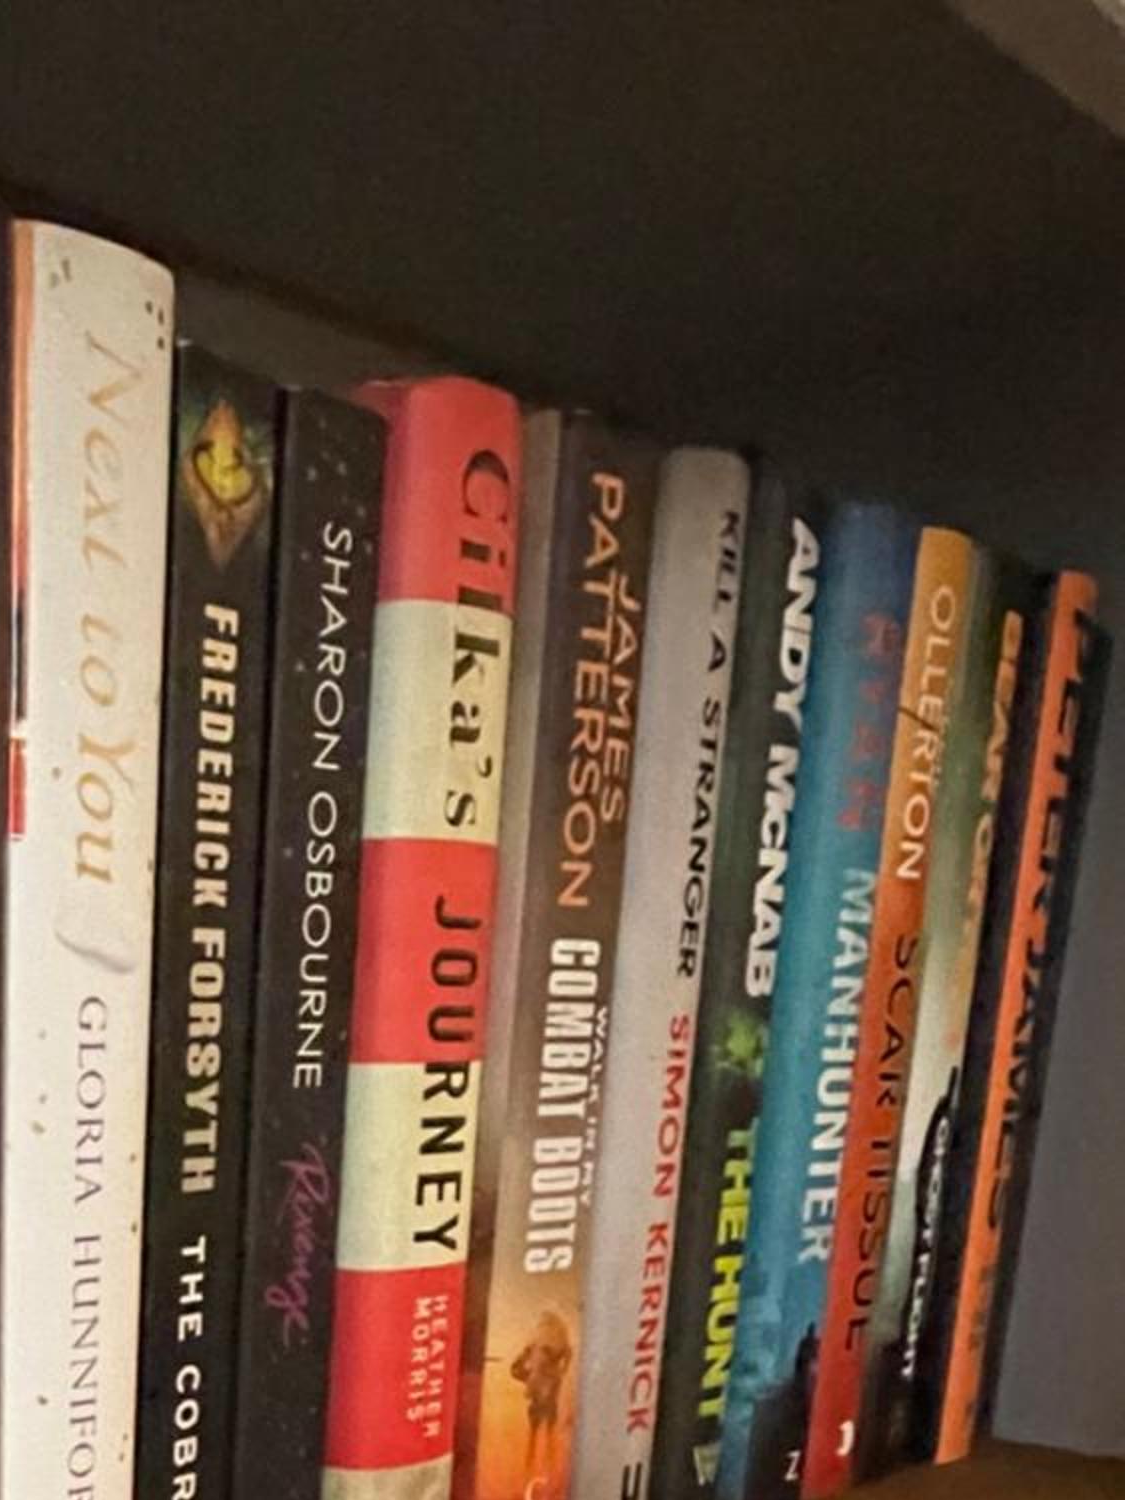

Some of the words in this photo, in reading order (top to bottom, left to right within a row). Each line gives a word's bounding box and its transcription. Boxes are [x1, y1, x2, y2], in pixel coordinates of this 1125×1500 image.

[82, 329, 145, 574] Next
[81, 614, 125, 708] to
[313, 521, 353, 772] SHARON
[706, 632, 728, 673] A
[716, 510, 741, 612] KILL
[774, 516, 821, 735] ANDY
[192, 602, 240, 906] FREDERICK
[556, 471, 626, 908] PATTERSON
[599, 568, 642, 824] JAMES
[896, 584, 957, 880] OLLERTON
[75, 732, 137, 884] You
[676, 697, 727, 979] STRANGER
[744, 743, 801, 999] McNAB
[293, 790, 338, 1089] OSBOURNE
[535, 937, 601, 1119] COMBAT
[874, 933, 923, 1108] SCAR
[75, 994, 107, 1204] GLORIA
[180, 924, 227, 1195] FORSYTH
[412, 896, 483, 1252] JOURNEY
[653, 1012, 691, 1200] SIMON
[797, 866, 879, 1264] MANHUNTER
[178, 1236, 207, 1338] THE
[264, 1141, 333, 1350] Revenge
[523, 1136, 583, 1275] BOOTS
[716, 1116, 760, 1253] THE
[843, 1138, 895, 1352] TISSUE
[406, 1297, 431, 1423] MORRIS
[423, 1294, 450, 1440] HEATHER
[626, 1221, 670, 1434] KERNICK
[698, 1254, 743, 1419] HUNT
